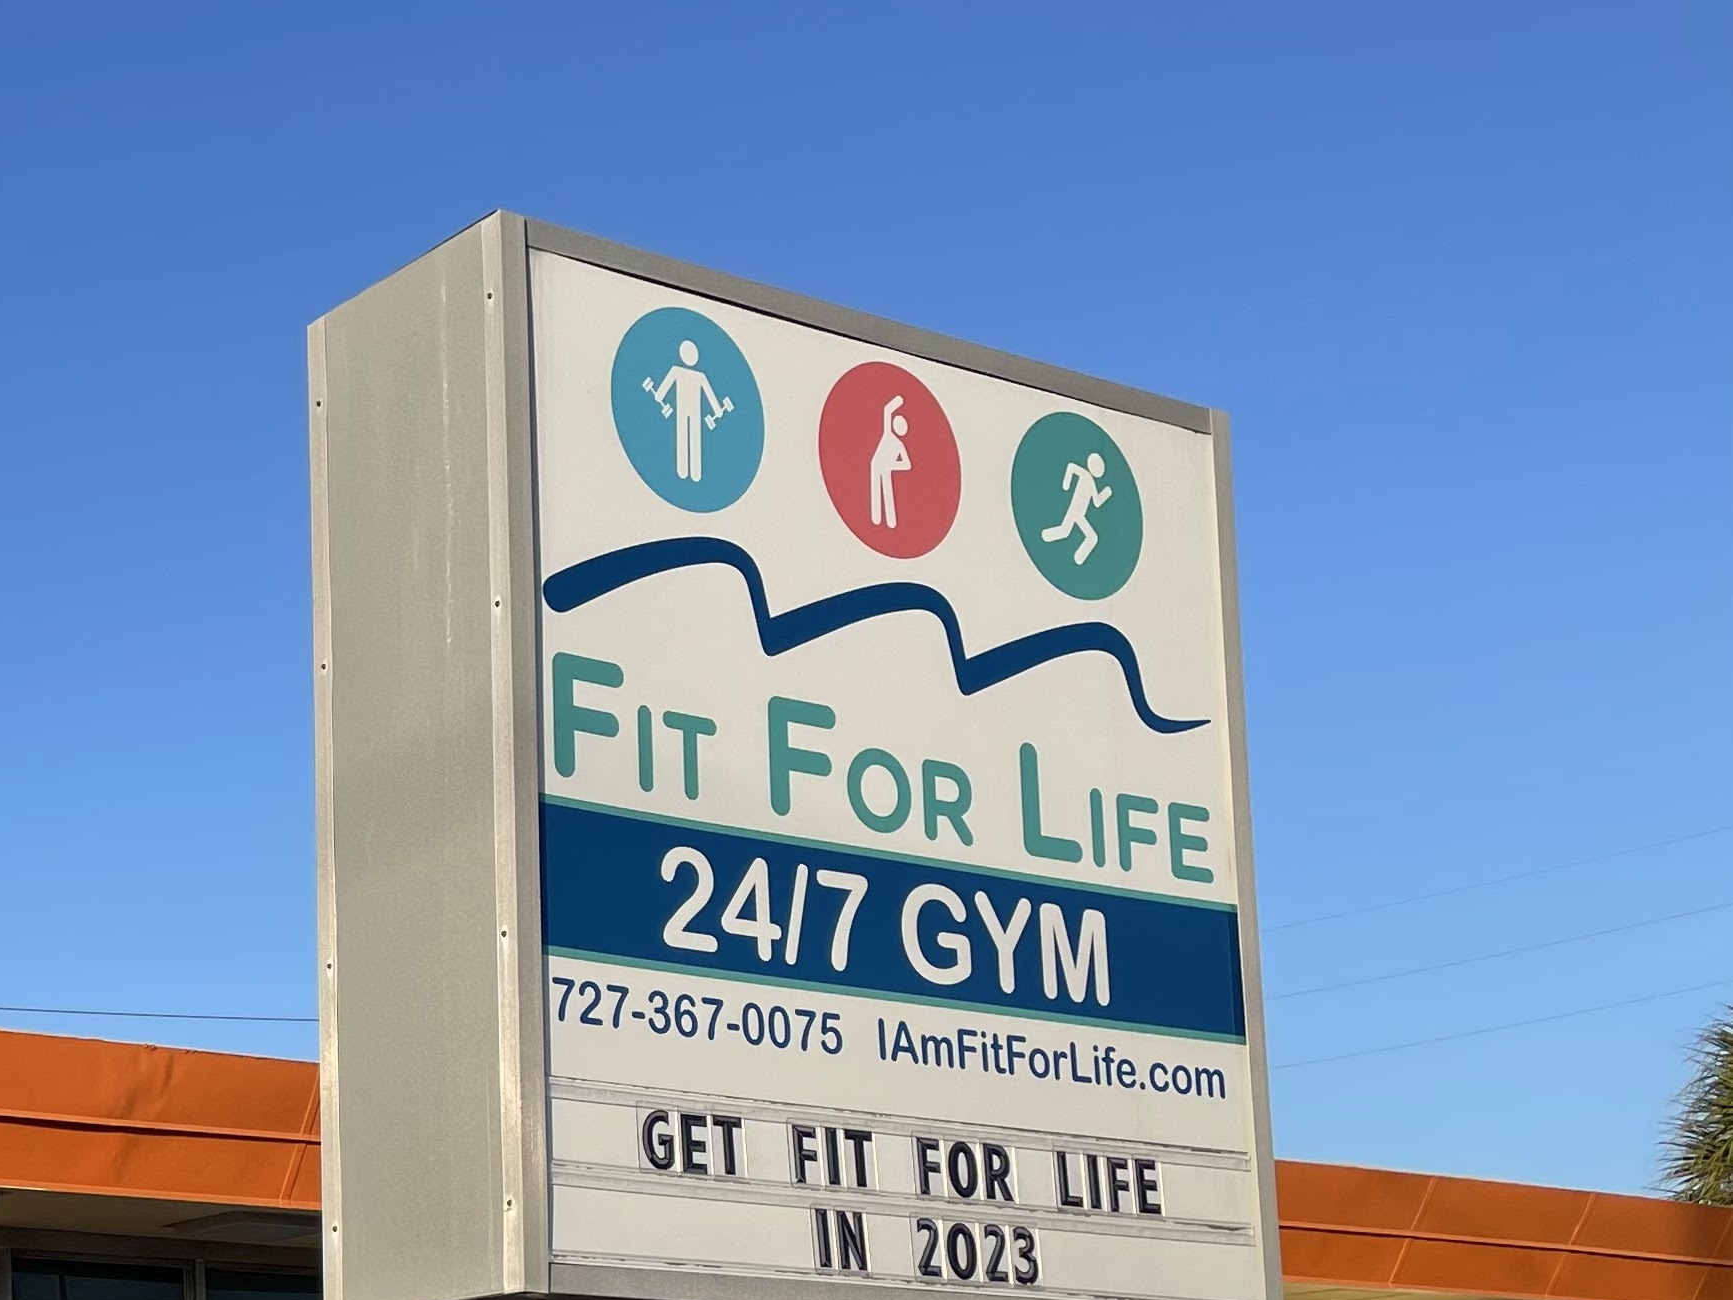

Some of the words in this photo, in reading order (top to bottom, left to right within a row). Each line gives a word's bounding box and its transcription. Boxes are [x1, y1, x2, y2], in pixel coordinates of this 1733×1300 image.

[552, 652, 717, 800] FIT
[768, 695, 973, 845] FOR
[1019, 743, 1214, 883] LIFE
[661, 846, 868, 972] 24/7
[901, 883, 1111, 1006] GYM
[552, 978, 843, 1054] 727-367-0075
[878, 1018, 1226, 1098] IAmFitForLife.com
[642, 1109, 743, 1176] GET
[792, 1125, 873, 1188] FIT
[918, 1137, 1014, 1201] FOR
[1056, 1150, 1160, 1214] LIFE
[815, 1208, 867, 1271] IN
[917, 1218, 1039, 1285] 2023
